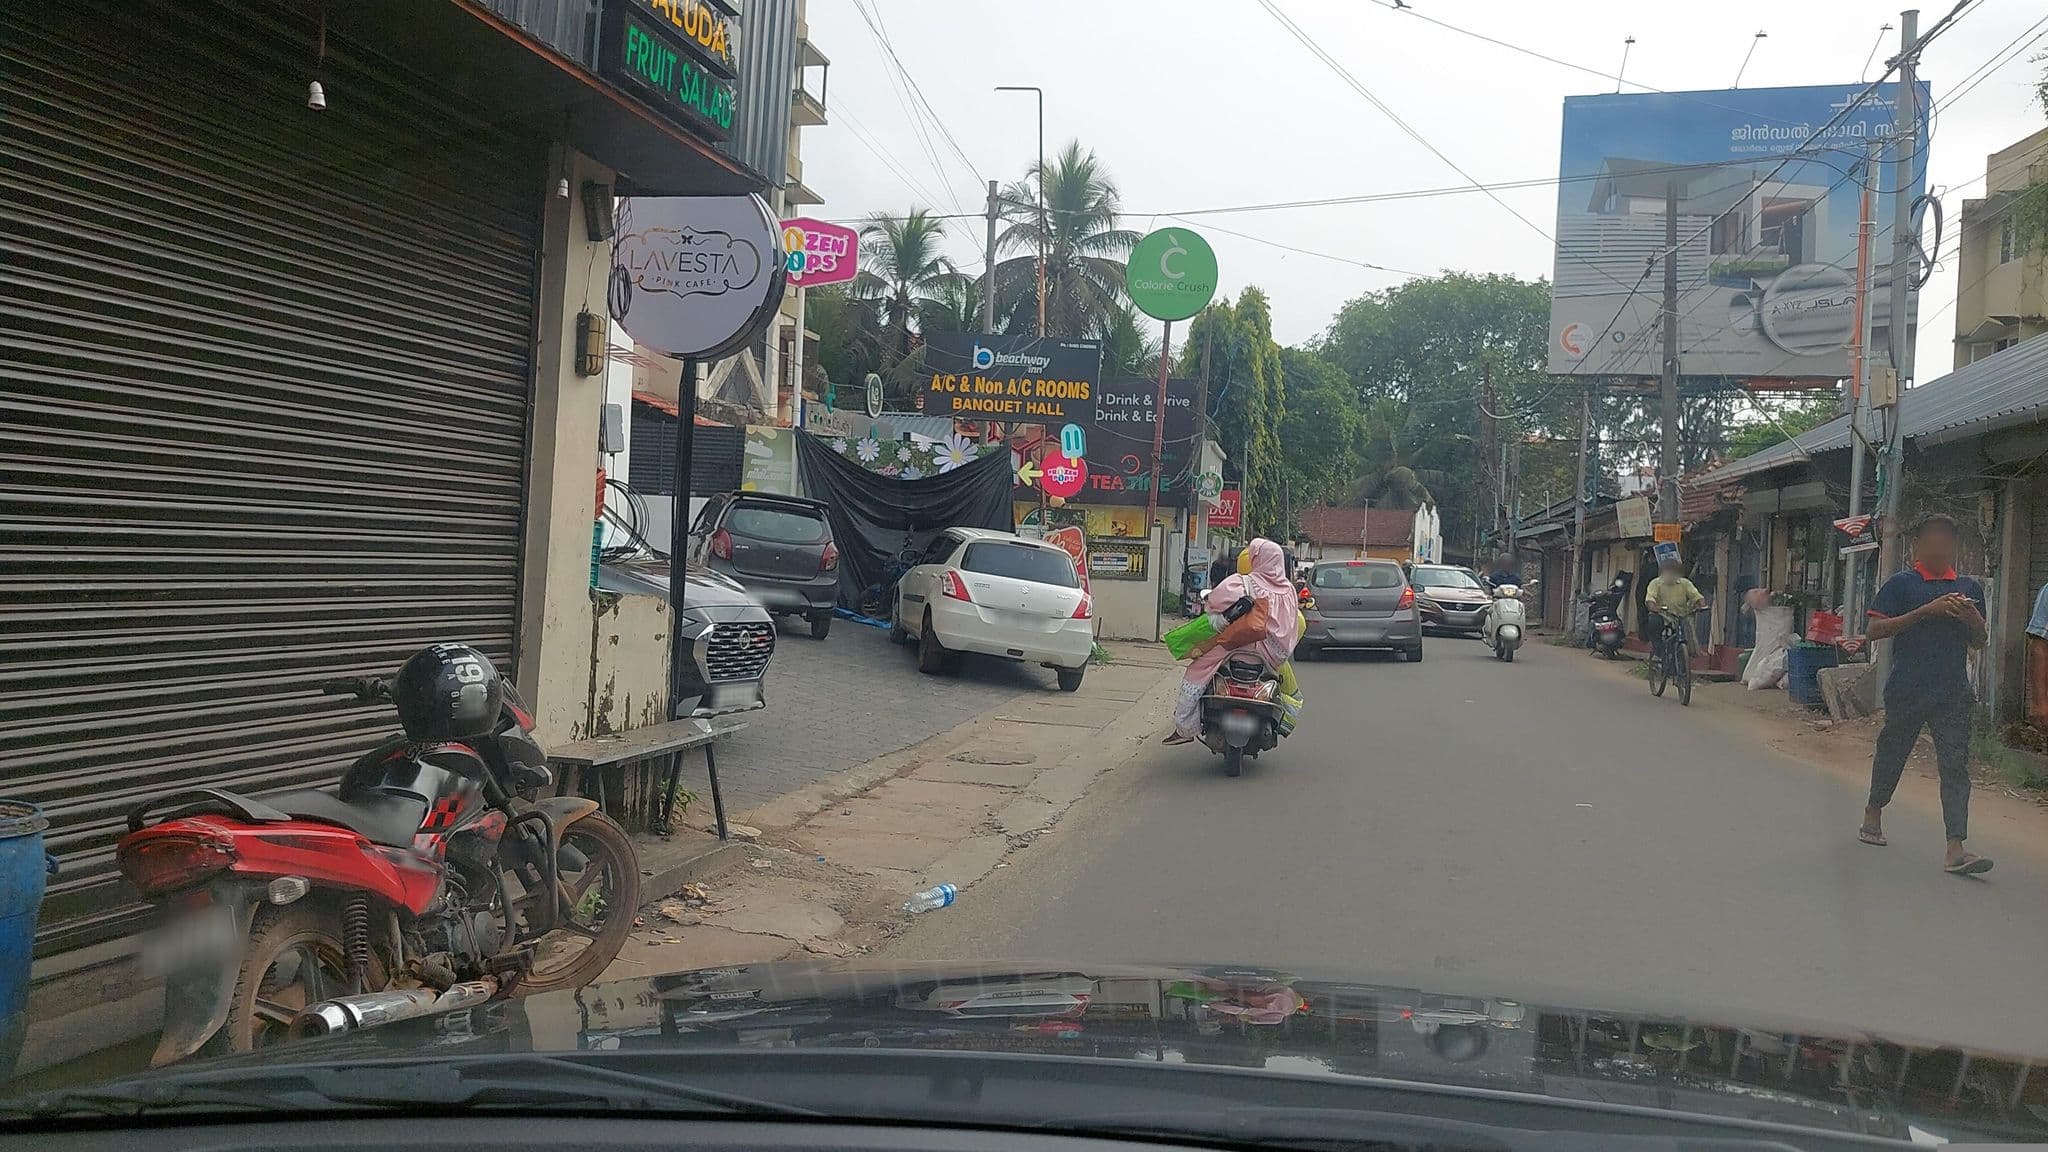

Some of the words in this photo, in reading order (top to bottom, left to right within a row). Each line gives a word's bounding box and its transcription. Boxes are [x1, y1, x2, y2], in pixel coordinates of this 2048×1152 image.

[626, 24, 677, 92] FRUIT
[680, 63, 732, 129] SALAD
[629, 250, 740, 276] LAVESTA
[656, 277, 680, 288] PINK
[686, 279, 712, 288] CAFE
[1134, 279, 1174, 291] Calorie
[1176, 281, 1209, 293] Crush
[995, 352, 1050, 370] beachway
[1028, 366, 1043, 374] inn
[931, 374, 956, 393] A/C
[959, 375, 971, 393] &
[975, 376, 1003, 395] Non
[1007, 378, 1032, 397] A/C
[1036, 379, 1090, 400] ROOMS
[952, 396, 1023, 414] BANQUET
[1026, 402, 1065, 416] HALL
[1106, 393, 1140, 406] Drink
[1143, 395, 1153, 406] &
[1162, 395, 1190, 407] rive
[1096, 409, 1129, 422] Drink
[1132, 411, 1142, 422] &
[1090, 474, 1125, 490] TEA
